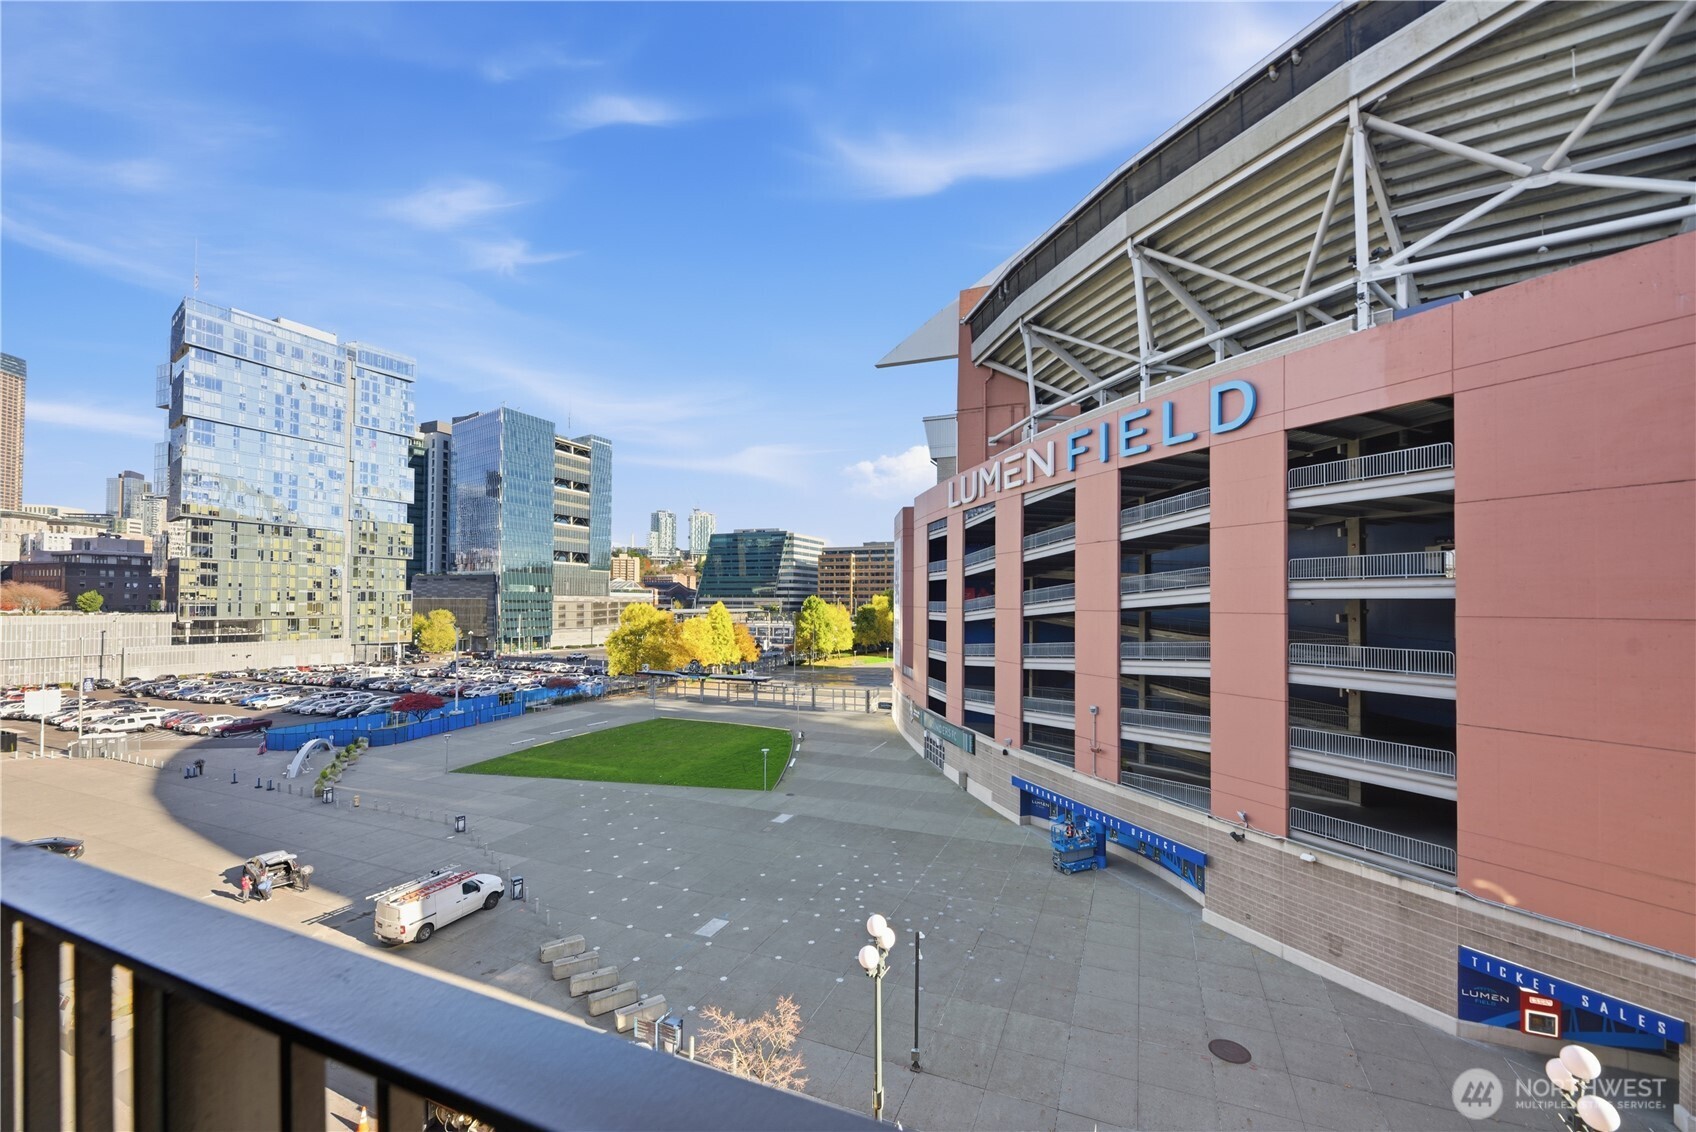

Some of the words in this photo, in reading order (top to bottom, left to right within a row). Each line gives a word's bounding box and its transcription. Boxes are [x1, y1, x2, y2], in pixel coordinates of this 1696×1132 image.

[948, 440, 1055, 508] LUMEN
[1067, 379, 1257, 472] FIELD
[1083, 807, 1120, 830] TICKET
[1131, 827, 1177, 853] OFFICE
[1461, 988, 1510, 1004] LUMEN
[1471, 956, 1556, 996] TICKET
[1581, 995, 1667, 1035] SALES
[1474, 998, 1497, 1007] FIELD
